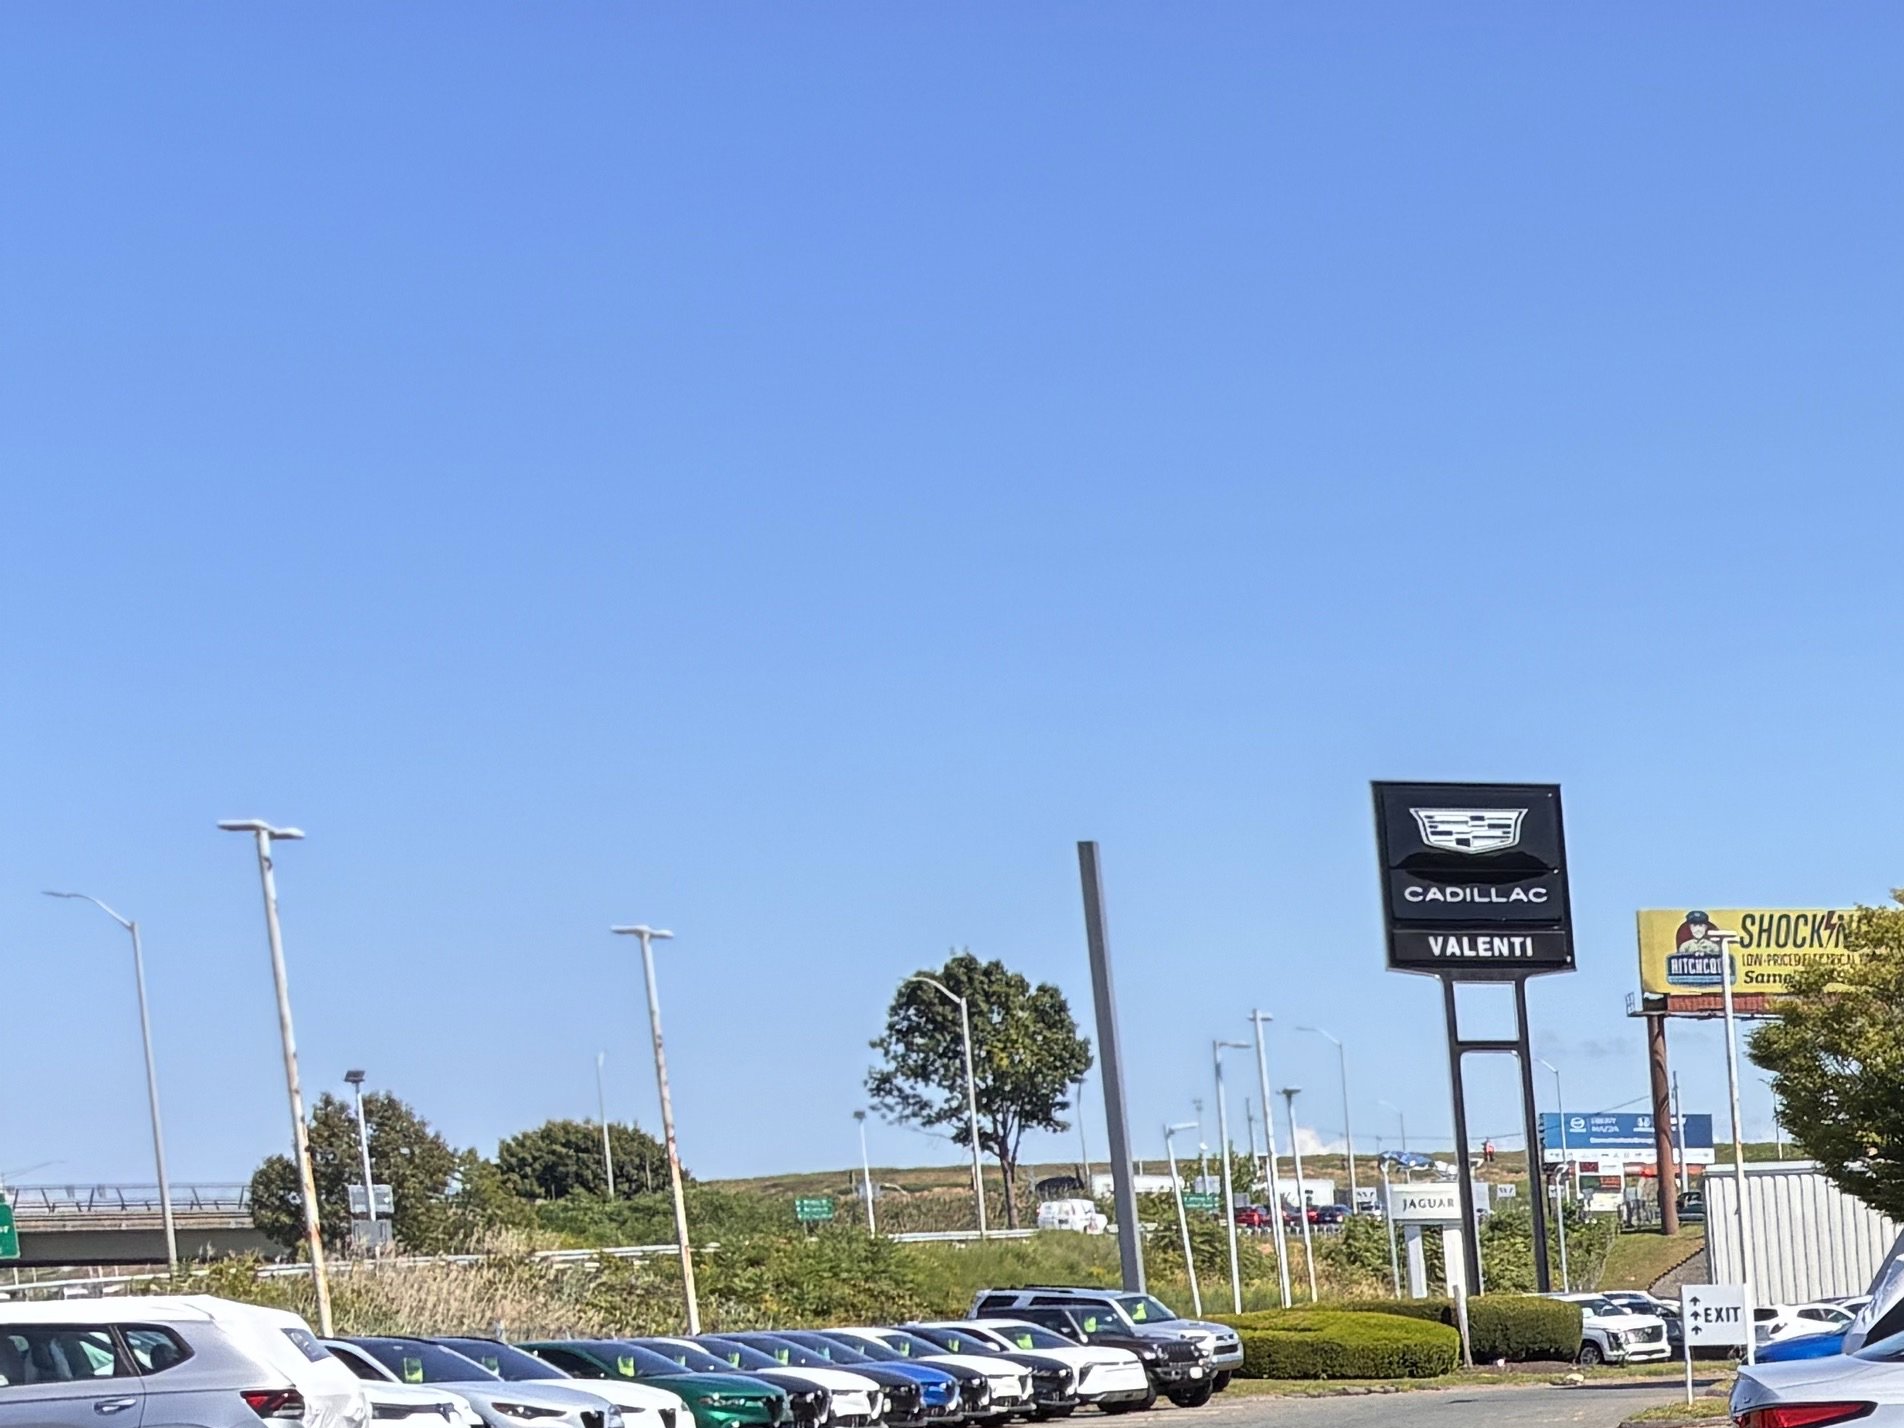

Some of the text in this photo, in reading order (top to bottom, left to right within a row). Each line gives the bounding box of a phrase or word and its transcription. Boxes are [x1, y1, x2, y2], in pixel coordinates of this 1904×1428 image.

[1404, 886, 1548, 903] CADILLAC
[1428, 936, 1533, 957] VALENTI
[1402, 1198, 1455, 1212] JAGUAR
[1704, 1306, 1741, 1323] EXIT
